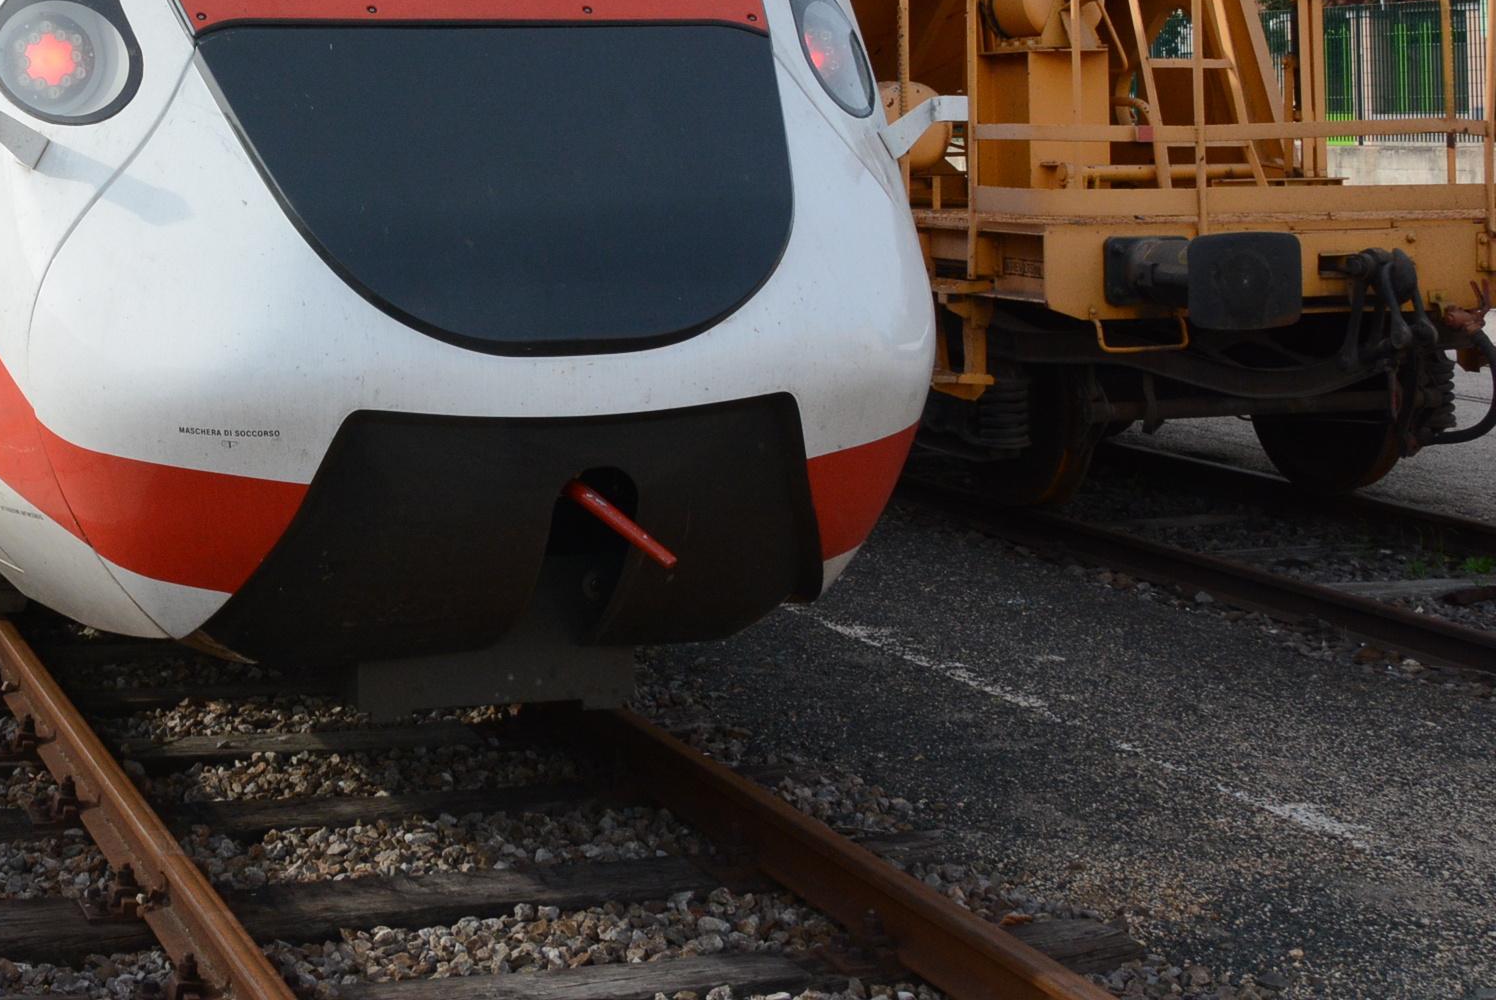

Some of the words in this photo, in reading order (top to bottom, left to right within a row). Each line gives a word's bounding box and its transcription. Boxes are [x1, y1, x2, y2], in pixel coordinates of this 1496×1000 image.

[178, 426, 222, 437] MASCHERA
[224, 429, 233, 437] DI
[234, 430, 281, 438] SOCCORSO
